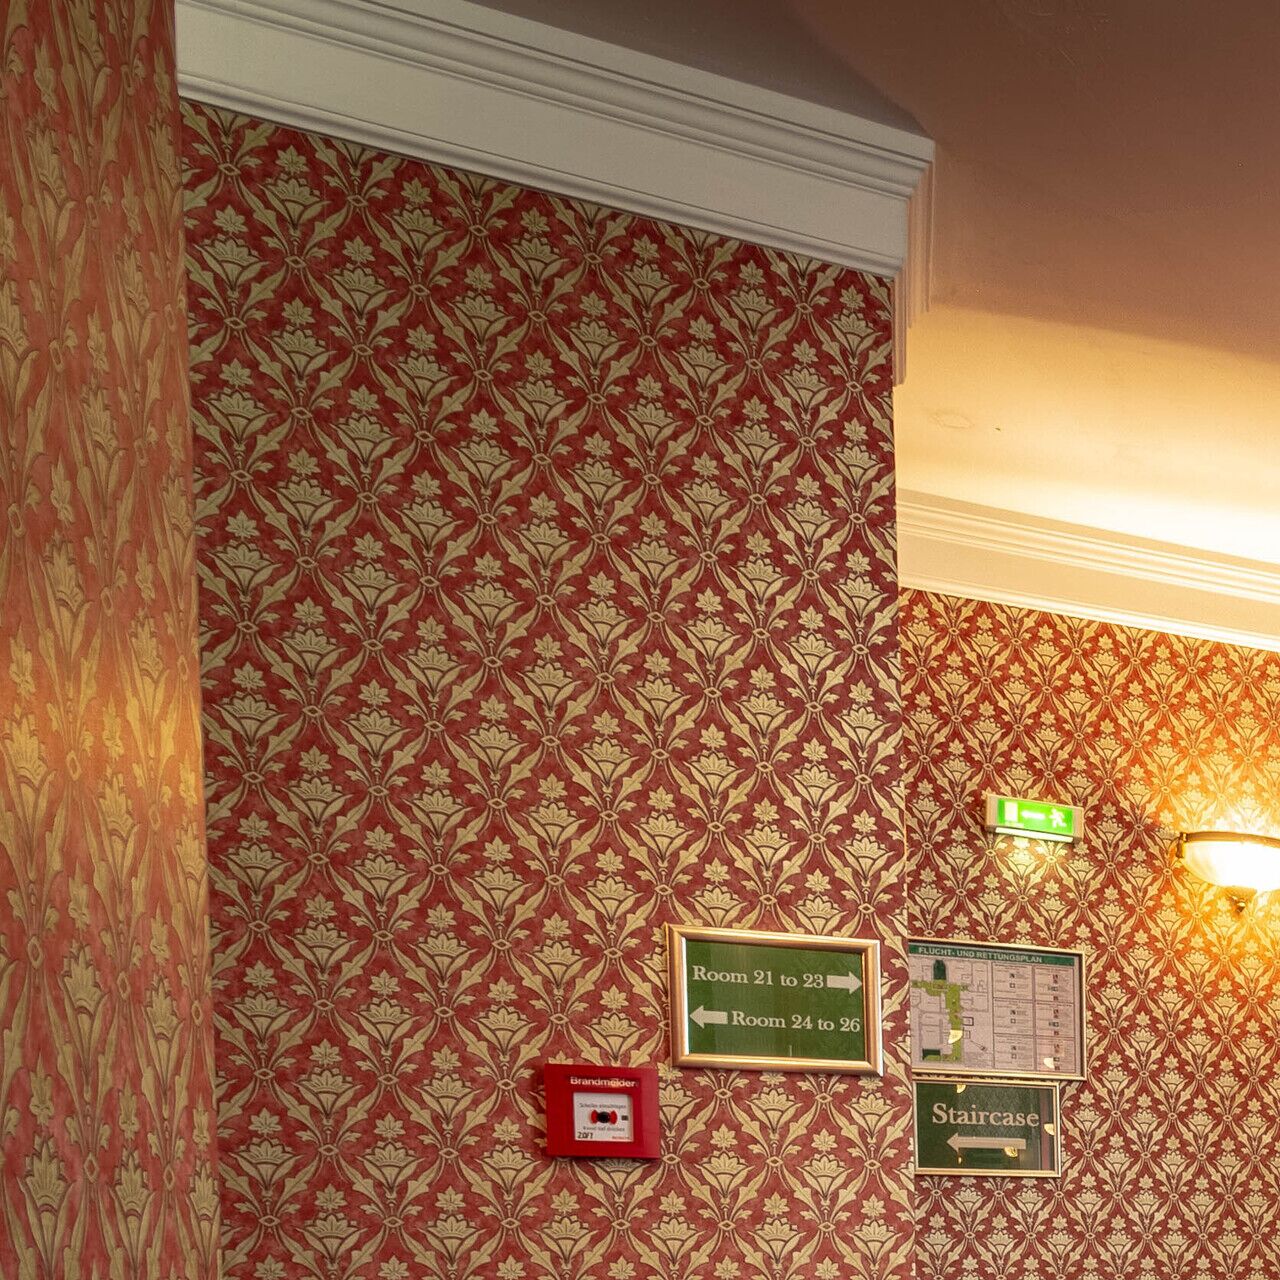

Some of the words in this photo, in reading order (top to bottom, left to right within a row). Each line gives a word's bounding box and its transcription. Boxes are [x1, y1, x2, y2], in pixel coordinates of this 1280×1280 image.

[918, 947, 956, 956] FLUCHT-
[957, 949, 975, 958] UND
[976, 951, 1042, 963] RETTUNGSPLAN
[692, 965, 748, 984] Room
[753, 970, 774, 986] 21
[780, 974, 798, 987] to
[803, 973, 824, 988] 23
[731, 1010, 786, 1029] Room
[791, 1015, 813, 1030] 24
[818, 1018, 835, 1031] to
[839, 1017, 861, 1032] 26
[570, 1076, 636, 1088] Brandmelder
[932, 1103, 1040, 1127] Staircase
